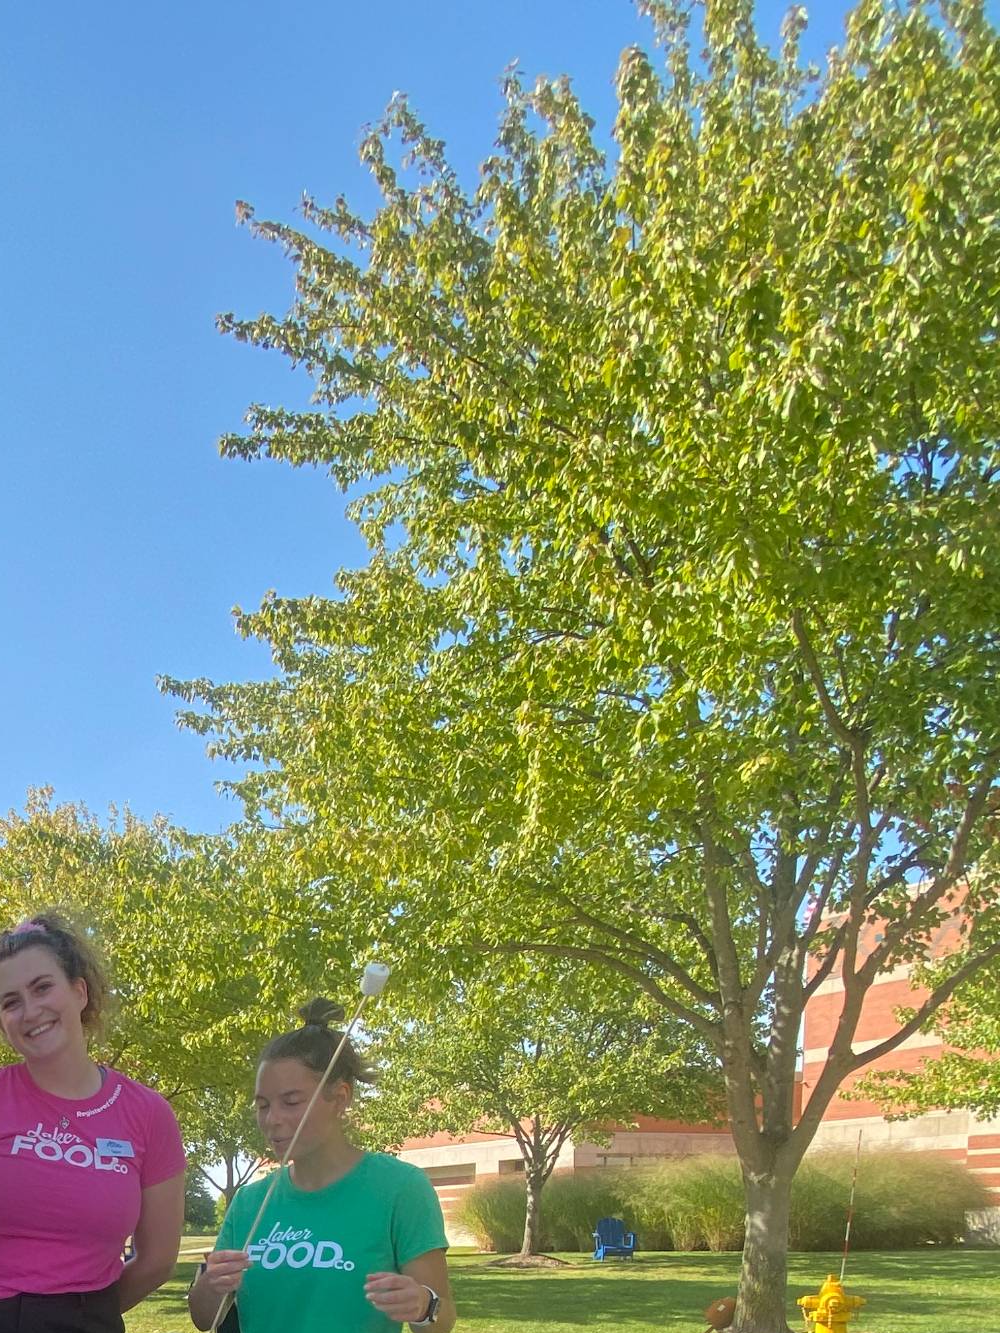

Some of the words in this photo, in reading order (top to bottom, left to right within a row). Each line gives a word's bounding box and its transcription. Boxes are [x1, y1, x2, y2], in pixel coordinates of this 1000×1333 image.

[76, 1102, 109, 1118] Registered
[27, 1123, 83, 1144] Laker
[258, 1221, 314, 1246] Laker
[246, 1241, 344, 1270] FOOD
